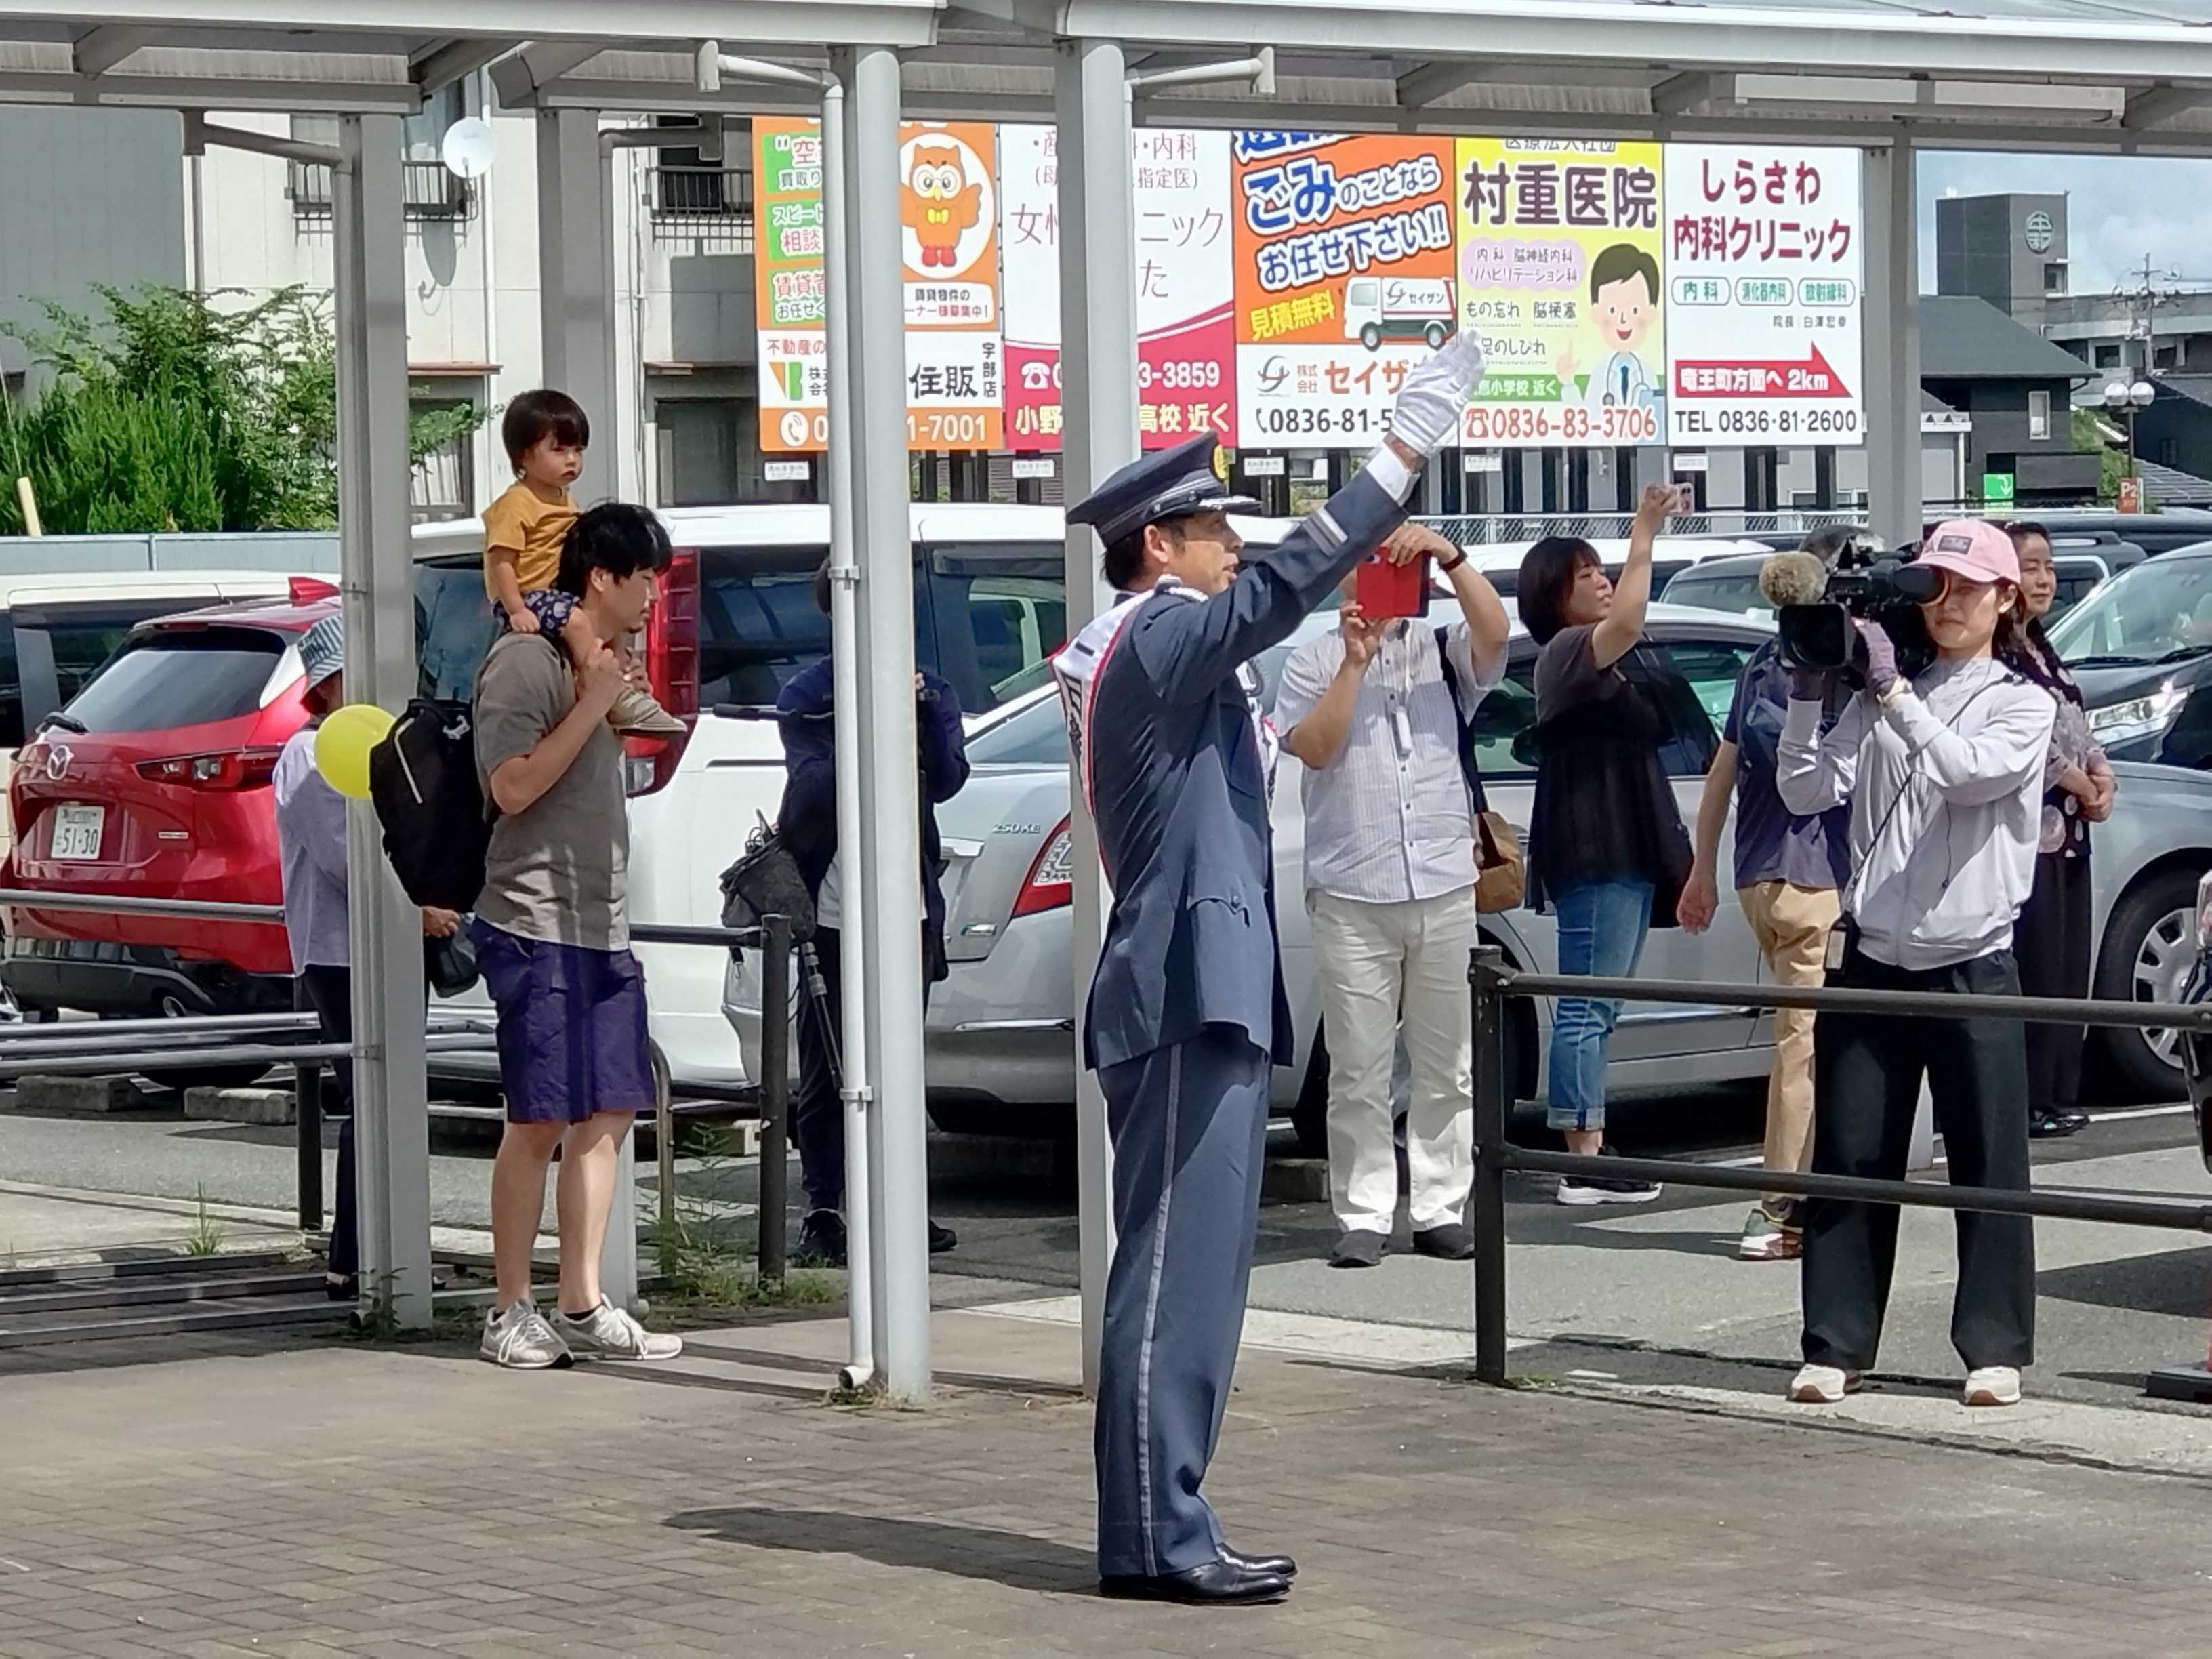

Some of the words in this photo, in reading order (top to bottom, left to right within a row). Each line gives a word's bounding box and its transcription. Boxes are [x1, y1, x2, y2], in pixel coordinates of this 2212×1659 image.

[1248, 161, 1438, 228] ごみのことなら
[1463, 161, 1658, 228] 村重医院
[1702, 159, 1821, 204] しらさわ
[783, 228, 821, 253] 相談
[1140, 207, 1223, 247] ニック
[1673, 214, 1851, 262] 内科クリニック
[1262, 209, 1447, 284] お任せ下さい!!
[1139, 259, 1169, 297] た
[1469, 268, 1578, 283] リハビリテーション科
[1408, 293, 1446, 304] セイザン
[1683, 281, 1719, 301] 内科
[1742, 281, 1786, 302] 消化器内科
[1805, 282, 1847, 302] 放射線科
[1250, 289, 1335, 341] 見積無料
[1466, 301, 1521, 319] もの忘れ
[1533, 301, 1577, 319] 脳梗塞
[767, 339, 825, 355] 不動産の
[1481, 337, 1547, 356] 足のしびれ
[909, 363, 978, 399] 住販
[982, 342, 996, 398] 宇部店
[1138, 361, 1220, 388] 3-3859
[1297, 365, 1318, 377] 株式
[1787, 369, 1829, 390] 2km
[1297, 381, 1318, 394] 会社
[1533, 379, 1557, 396] 近く
[1139, 404, 1182, 433] 高校
[1187, 403, 1229, 432] 近く
[1492, 407, 1656, 438] 0836-83-3706
[1675, 410, 1713, 432] TEL
